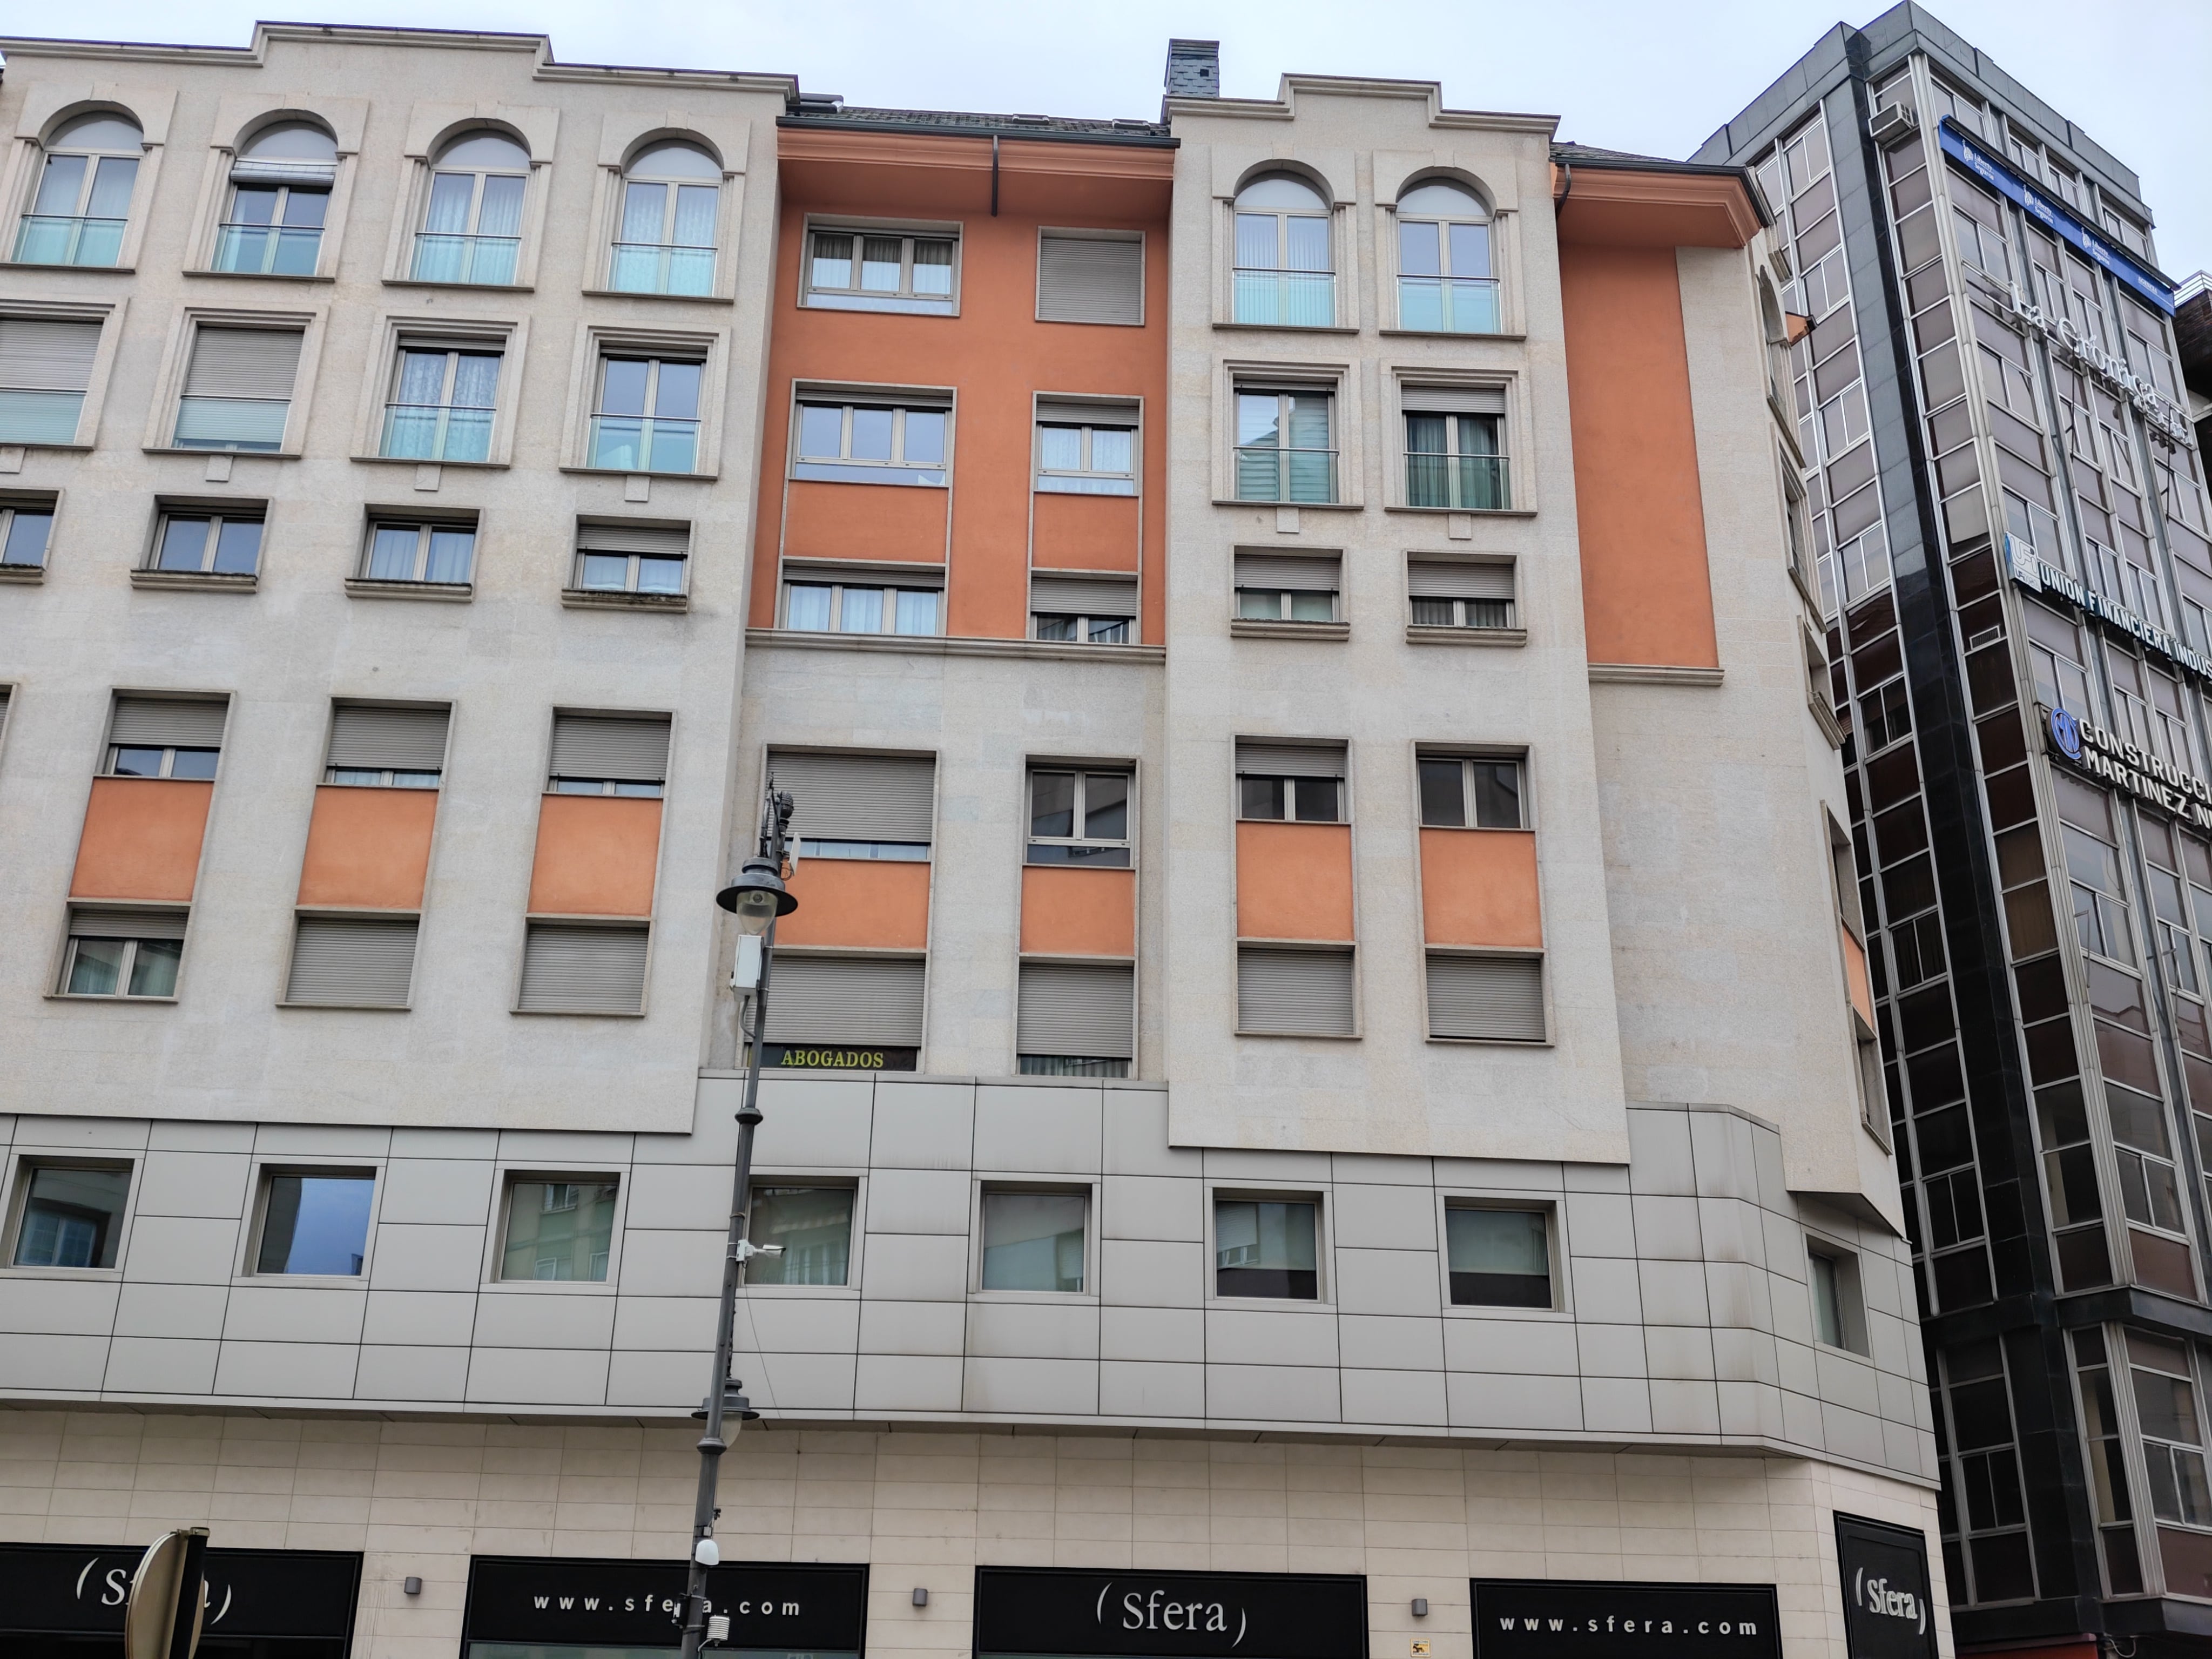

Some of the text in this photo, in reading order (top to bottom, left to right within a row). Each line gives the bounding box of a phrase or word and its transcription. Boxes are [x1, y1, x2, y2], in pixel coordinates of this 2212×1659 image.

[2007, 280, 2048, 335] La
[2039, 563, 2086, 607] UNION
[2087, 590, 2172, 657] FINANCIERA
[2079, 718, 2212, 805] CONSTRUCCI
[2084, 745, 2212, 830] MARTINEZ N
[781, 1049, 884, 1068] ABOGADOS
[534, 1595, 800, 1616] www.sfea.com
[1500, 1615, 1757, 1635] www.sfera.com
